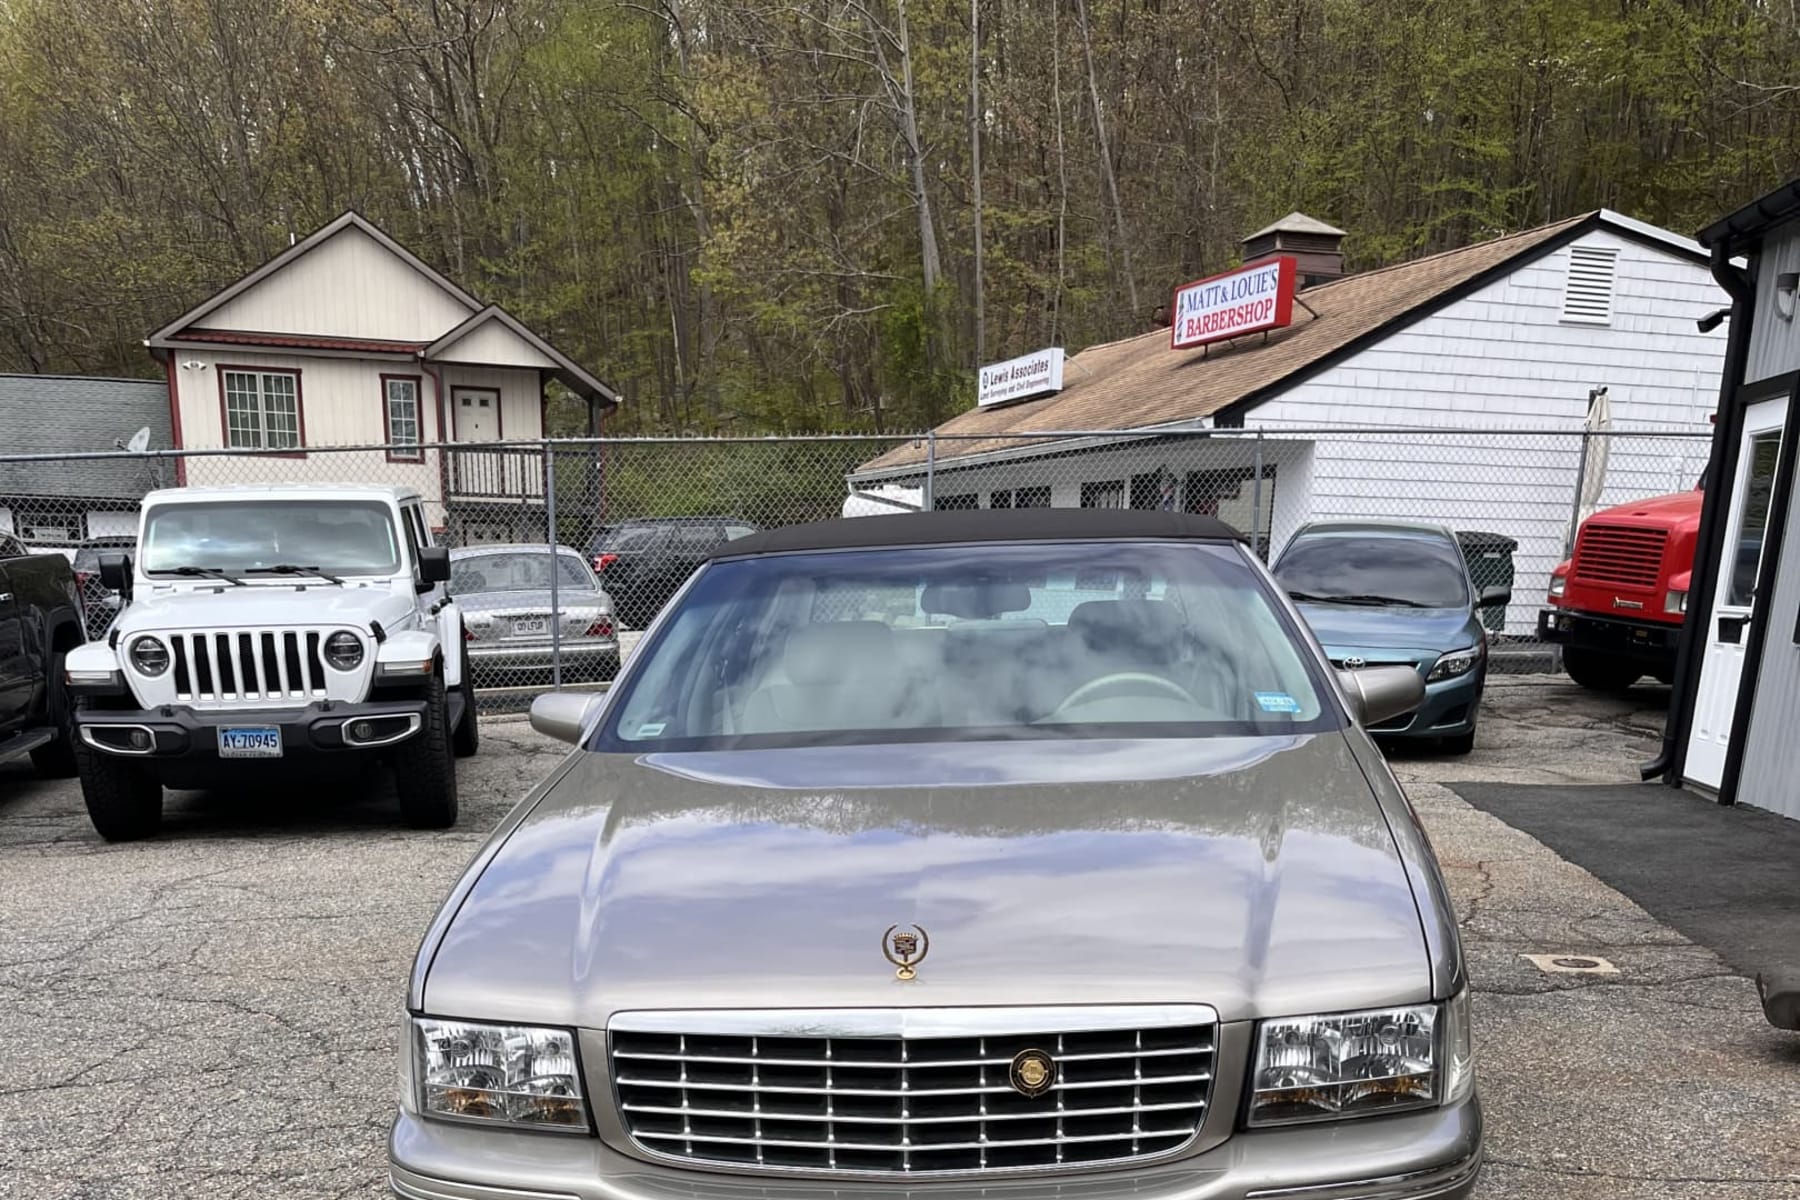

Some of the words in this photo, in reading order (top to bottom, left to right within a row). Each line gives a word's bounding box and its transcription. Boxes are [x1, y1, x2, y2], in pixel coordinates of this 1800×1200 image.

[1187, 285, 1220, 312] MATT
[1220, 286, 1228, 304] &
[1231, 268, 1278, 301] LOUIE'S
[1186, 298, 1273, 338] BARBERSHOP
[990, 368, 1009, 386] Lewis
[1011, 359, 1049, 380] Associates
